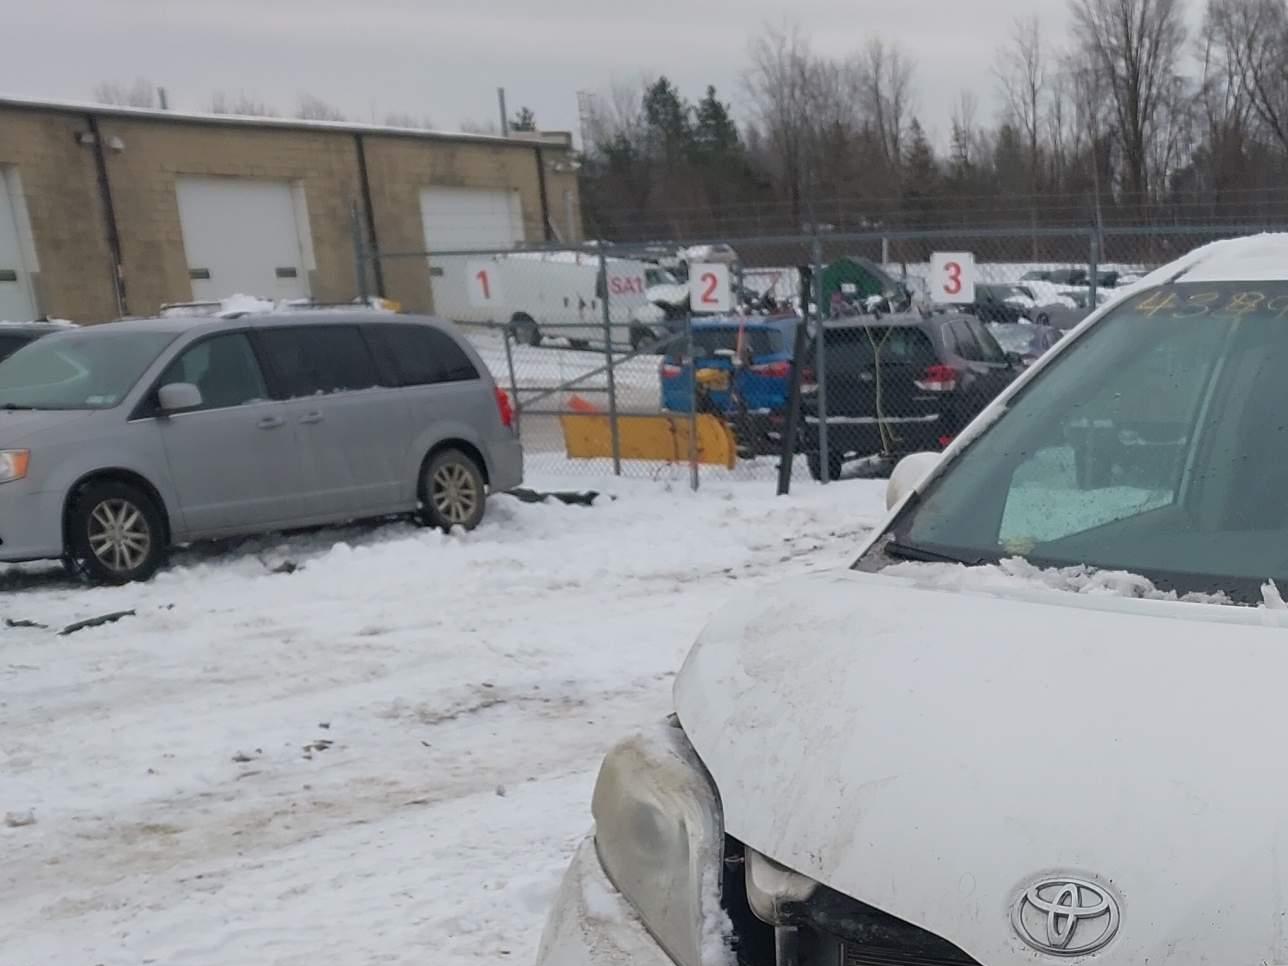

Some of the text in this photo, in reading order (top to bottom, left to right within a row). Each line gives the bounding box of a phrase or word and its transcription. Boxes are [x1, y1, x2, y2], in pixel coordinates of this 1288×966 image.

[475, 270, 490, 299] 1
[700, 273, 718, 303] 2
[943, 262, 961, 295] 3
